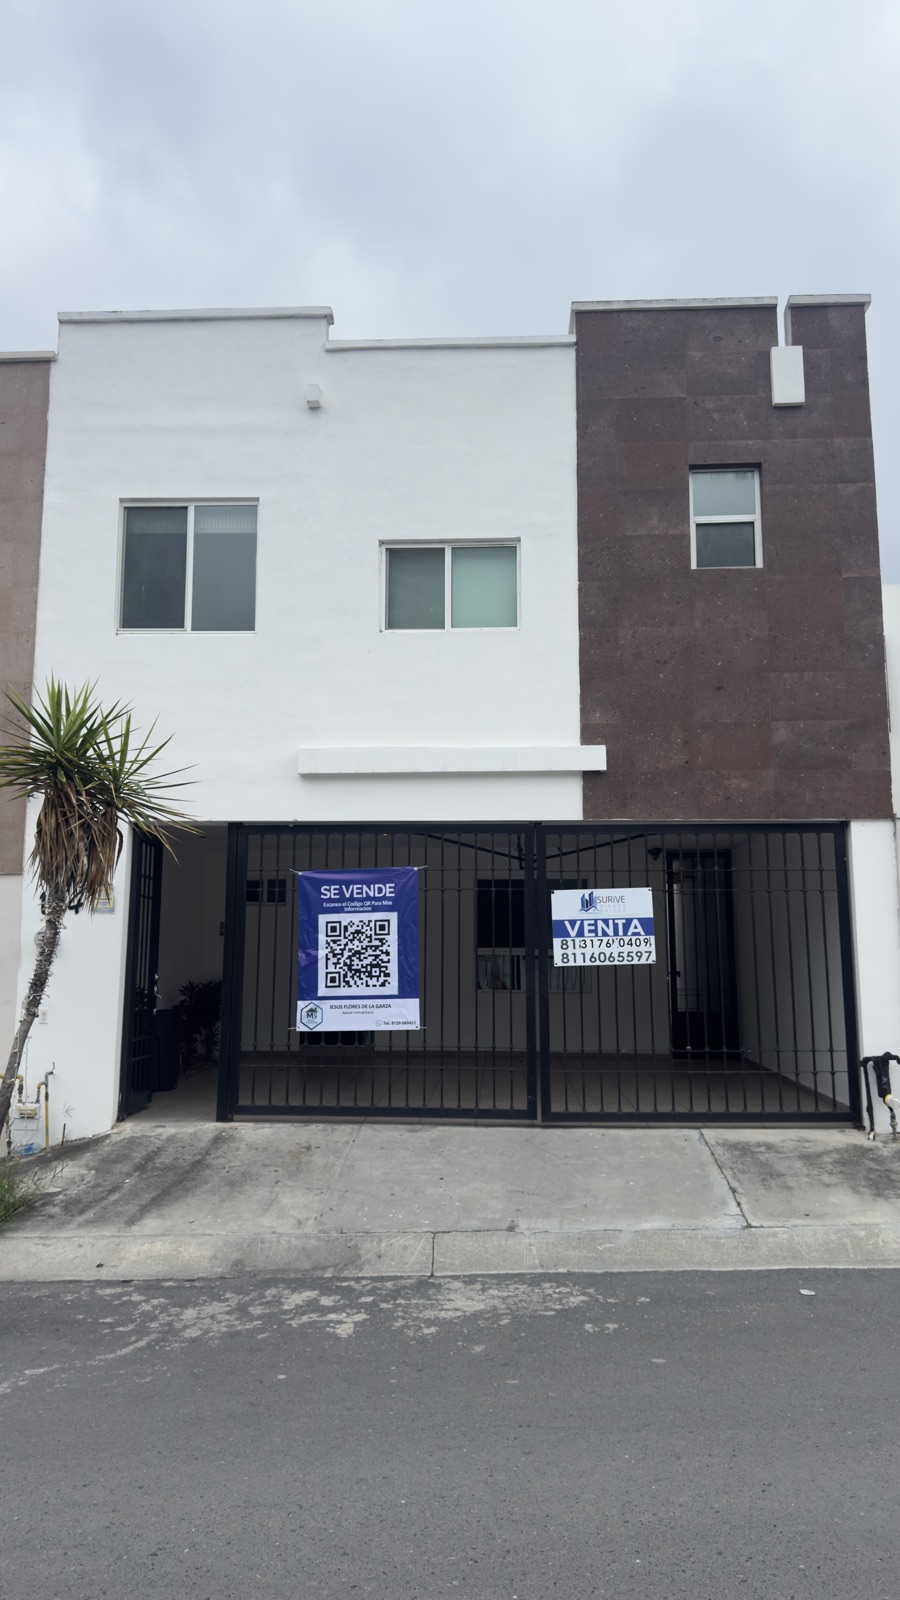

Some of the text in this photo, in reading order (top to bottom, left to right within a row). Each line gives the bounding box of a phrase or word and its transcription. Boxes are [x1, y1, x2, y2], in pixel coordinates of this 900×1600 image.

[320, 883, 396, 899] SE VENDE
[564, 918, 646, 938] VENTA
[561, 951, 653, 964] 8116065597
